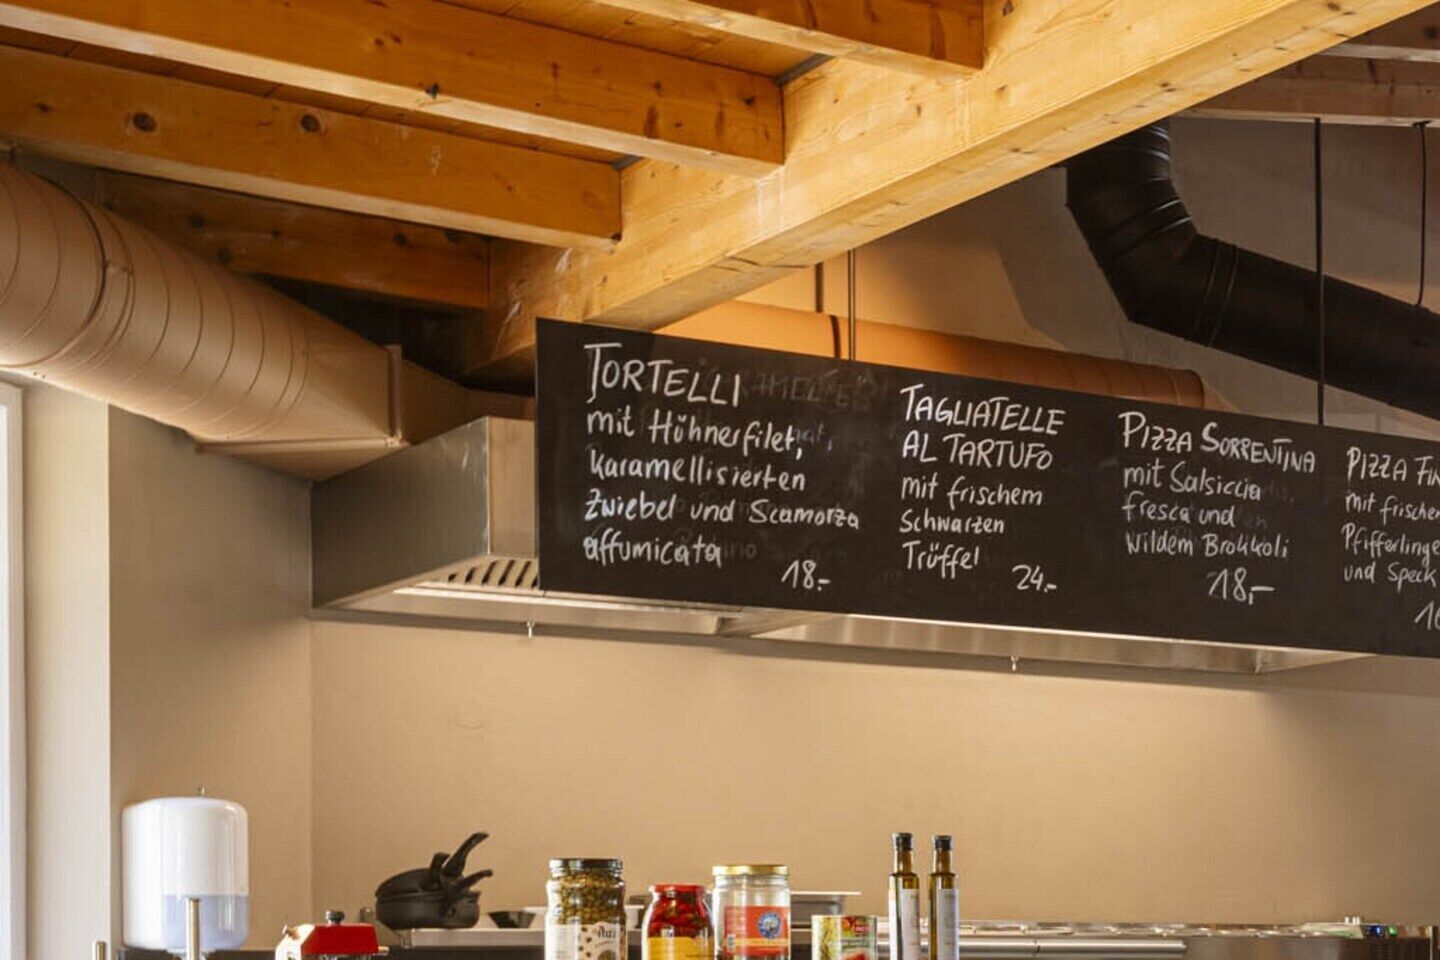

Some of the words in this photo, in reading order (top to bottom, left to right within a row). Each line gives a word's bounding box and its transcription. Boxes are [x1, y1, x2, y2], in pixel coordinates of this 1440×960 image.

[584, 342, 741, 408] TORTELLI
[900, 383, 1066, 436] TAGLIATELLE
[587, 405, 635, 437] mit
[648, 408, 803, 461] Hühnerfilet,
[902, 430, 937, 463] AL
[942, 433, 1053, 470] TARTUFO
[1118, 411, 1193, 454] PIZZA
[1124, 458, 1165, 488] mit
[1170, 461, 1261, 501] Salsiccia
[1346, 446, 1407, 482] PIZZA
[584, 488, 677, 522] Zwiebel
[690, 499, 735, 523] und
[749, 498, 860, 530] Scamorza
[901, 472, 938, 500] mit
[947, 476, 1043, 511] frischem
[1121, 491, 1191, 523] fresca
[1198, 506, 1236, 528] und
[1345, 491, 1377, 513] mit
[583, 528, 722, 568] affumicata
[902, 540, 980, 580] Trüffel
[1202, 533, 1290, 558] Brokkoli
[1344, 562, 1376, 584] und
[1387, 562, 1437, 594] Speck
